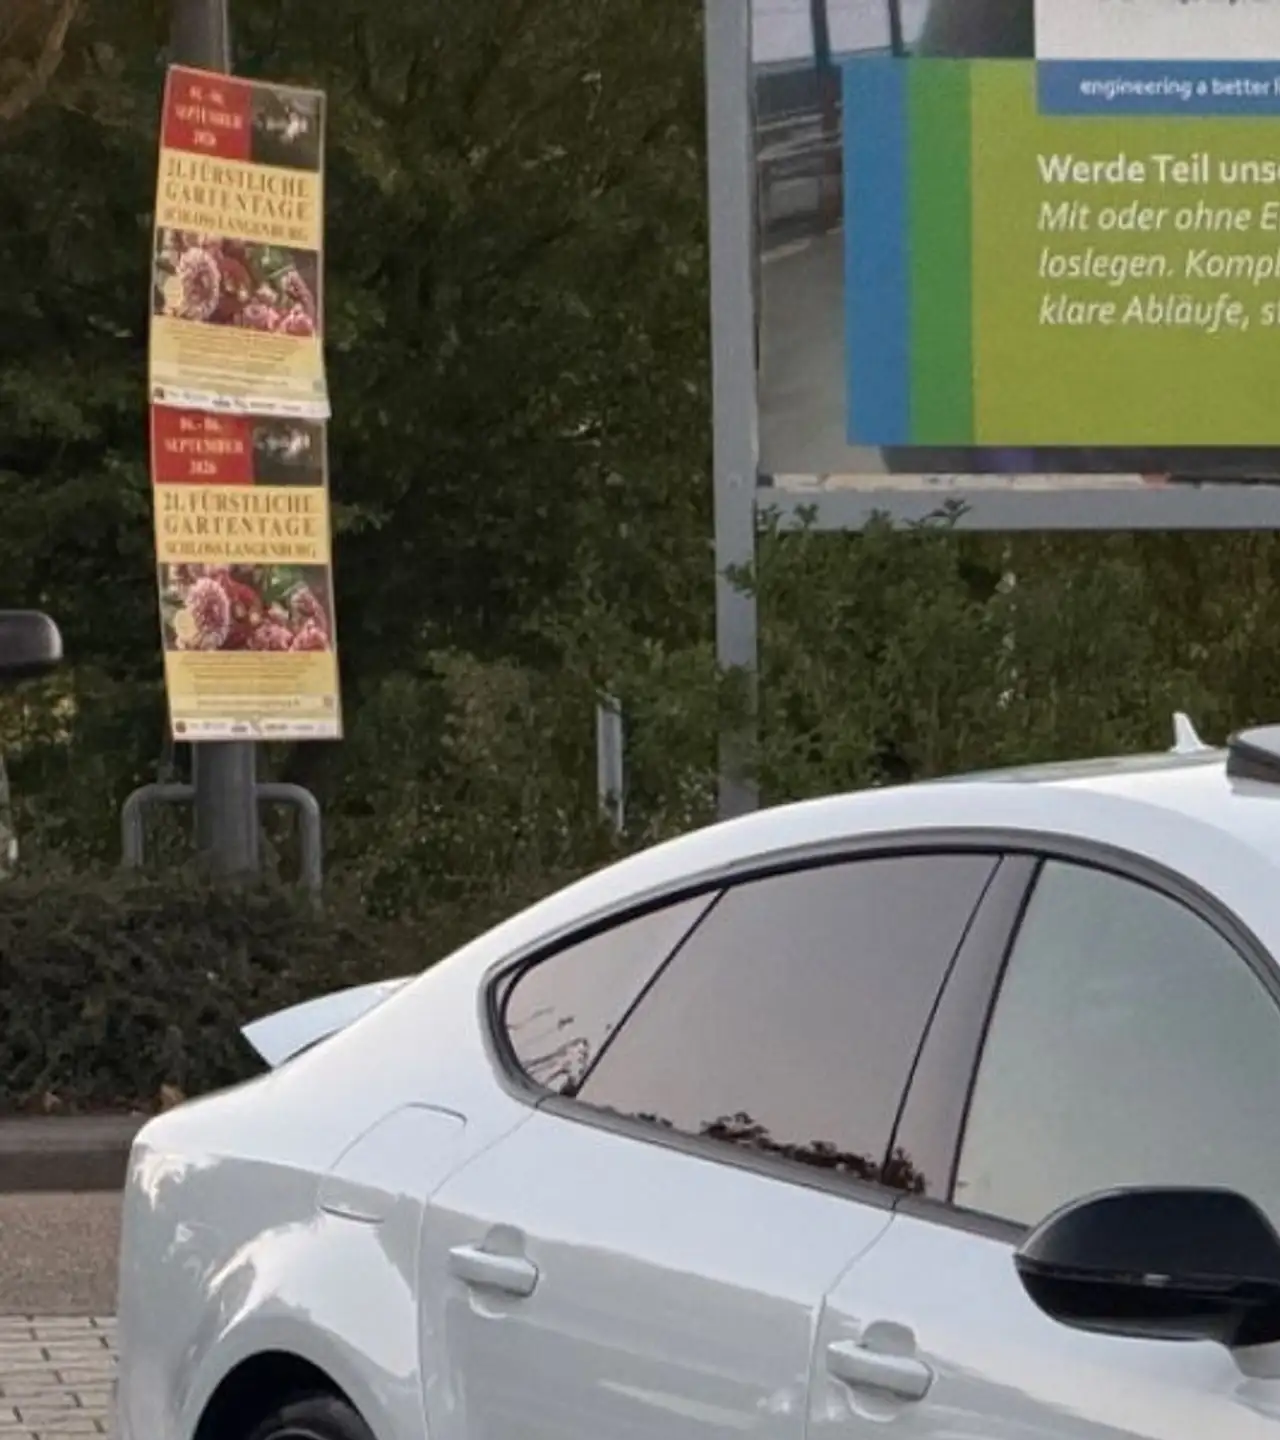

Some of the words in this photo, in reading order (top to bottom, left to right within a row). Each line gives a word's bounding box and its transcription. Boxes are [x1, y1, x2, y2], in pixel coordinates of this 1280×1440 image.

[1080, 77, 1192, 101] engineering
[1196, 82, 1208, 96] a
[1212, 78, 1270, 96] better
[189, 158, 310, 198] FÜRSTLICHE
[1037, 153, 1146, 184] Werde
[1152, 152, 1209, 184] Teil
[165, 181, 310, 221] GARTENTAGE
[1037, 201, 1090, 231] Mit
[1098, 200, 1169, 232] oder
[1174, 200, 1252, 232] ohne
[1038, 248, 1174, 287] loslegen.
[1039, 294, 1116, 325] klare
[1121, 293, 1249, 333] Abläufe,
[163, 491, 186, 512] 21.
[189, 490, 315, 514] FÜRSTLICHE
[163, 515, 317, 538] GARTENTAGE
